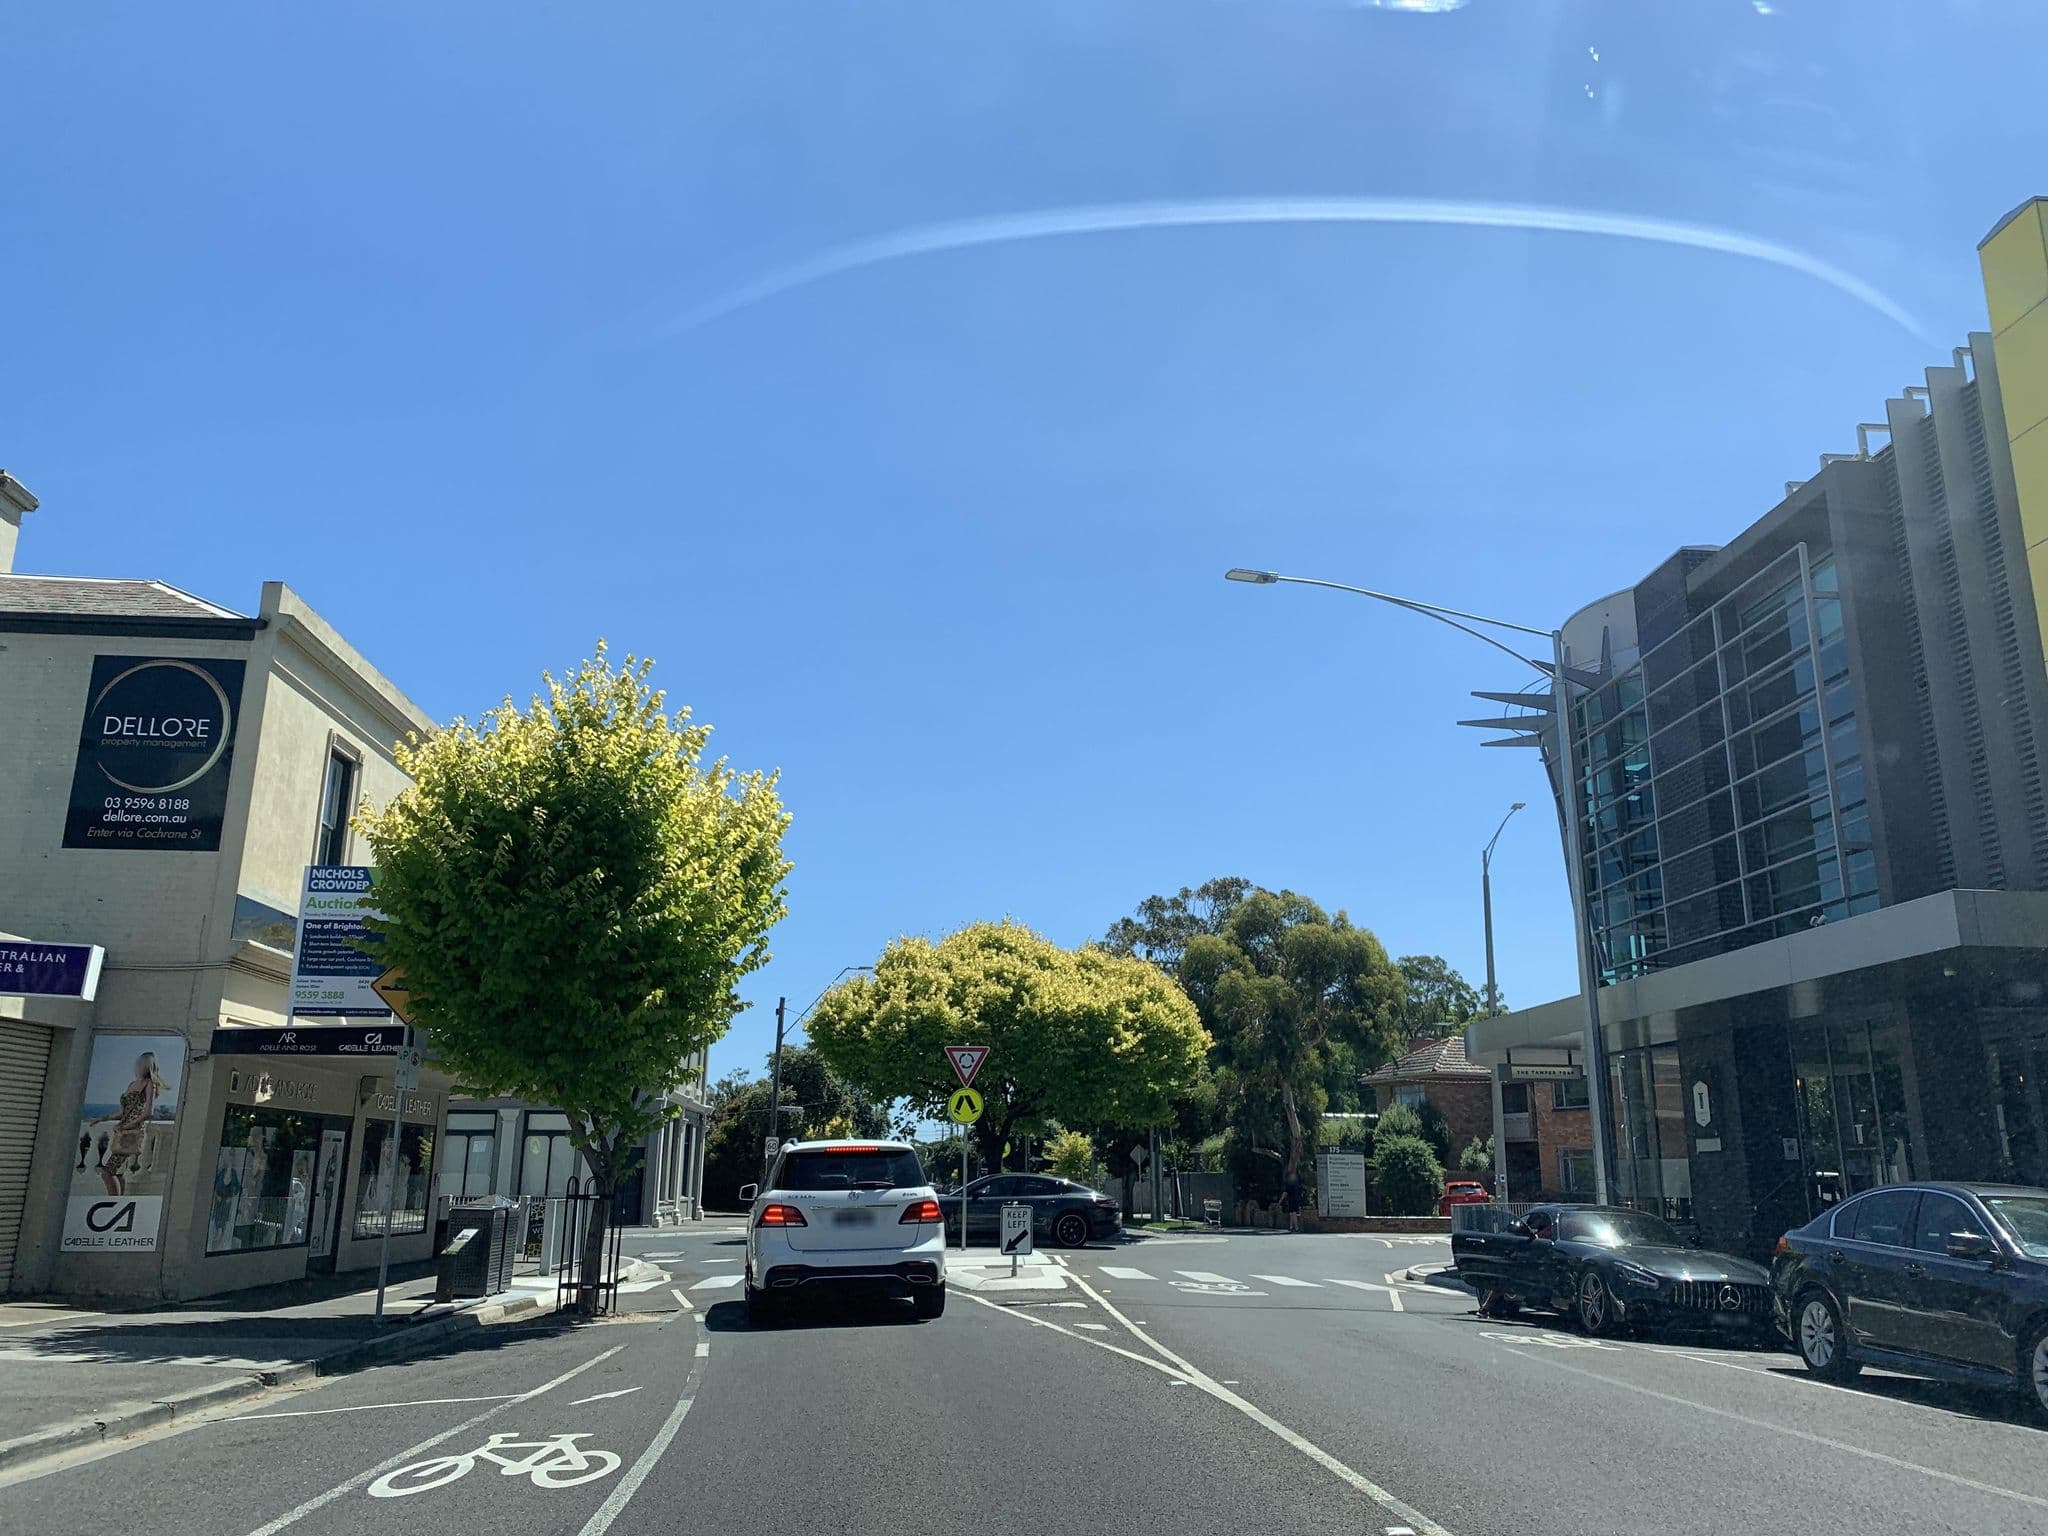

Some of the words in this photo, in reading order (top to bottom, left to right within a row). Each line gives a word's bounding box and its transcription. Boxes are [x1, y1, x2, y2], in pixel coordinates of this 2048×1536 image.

[103, 716, 211, 738] DELLORE
[101, 738, 141, 747] property
[143, 739, 207, 748] management
[104, 797, 120, 809] 03
[124, 798, 155, 809] 9596
[158, 799, 190, 810] 8188
[103, 809, 187, 823] dellore.com.au
[87, 827, 117, 838] Enter
[118, 828, 134, 838] via
[136, 828, 187, 839] Cochrane
[190, 829, 202, 840] St
[311, 869, 364, 879] NICHOLS
[333, 923, 371, 931] Brighto
[0, 950, 66, 963] TRALIAN
[15, 964, 25, 973] &
[295, 991, 319, 999] 9559
[321, 991, 345, 1000] 3888
[338, 1044, 368, 1052] CADELLE
[371, 1044, 400, 1052] LEATHE
[377, 1094, 399, 1112] CADEL
[405, 1098, 431, 1116] LEATHER
[767, 1142, 777, 1150] 60
[1007, 1210, 1028, 1219] KEEP
[1007, 1220, 1027, 1229] LEFT
[64, 1237, 104, 1247] CADELLE
[108, 1237, 155, 1247] LEATHER
